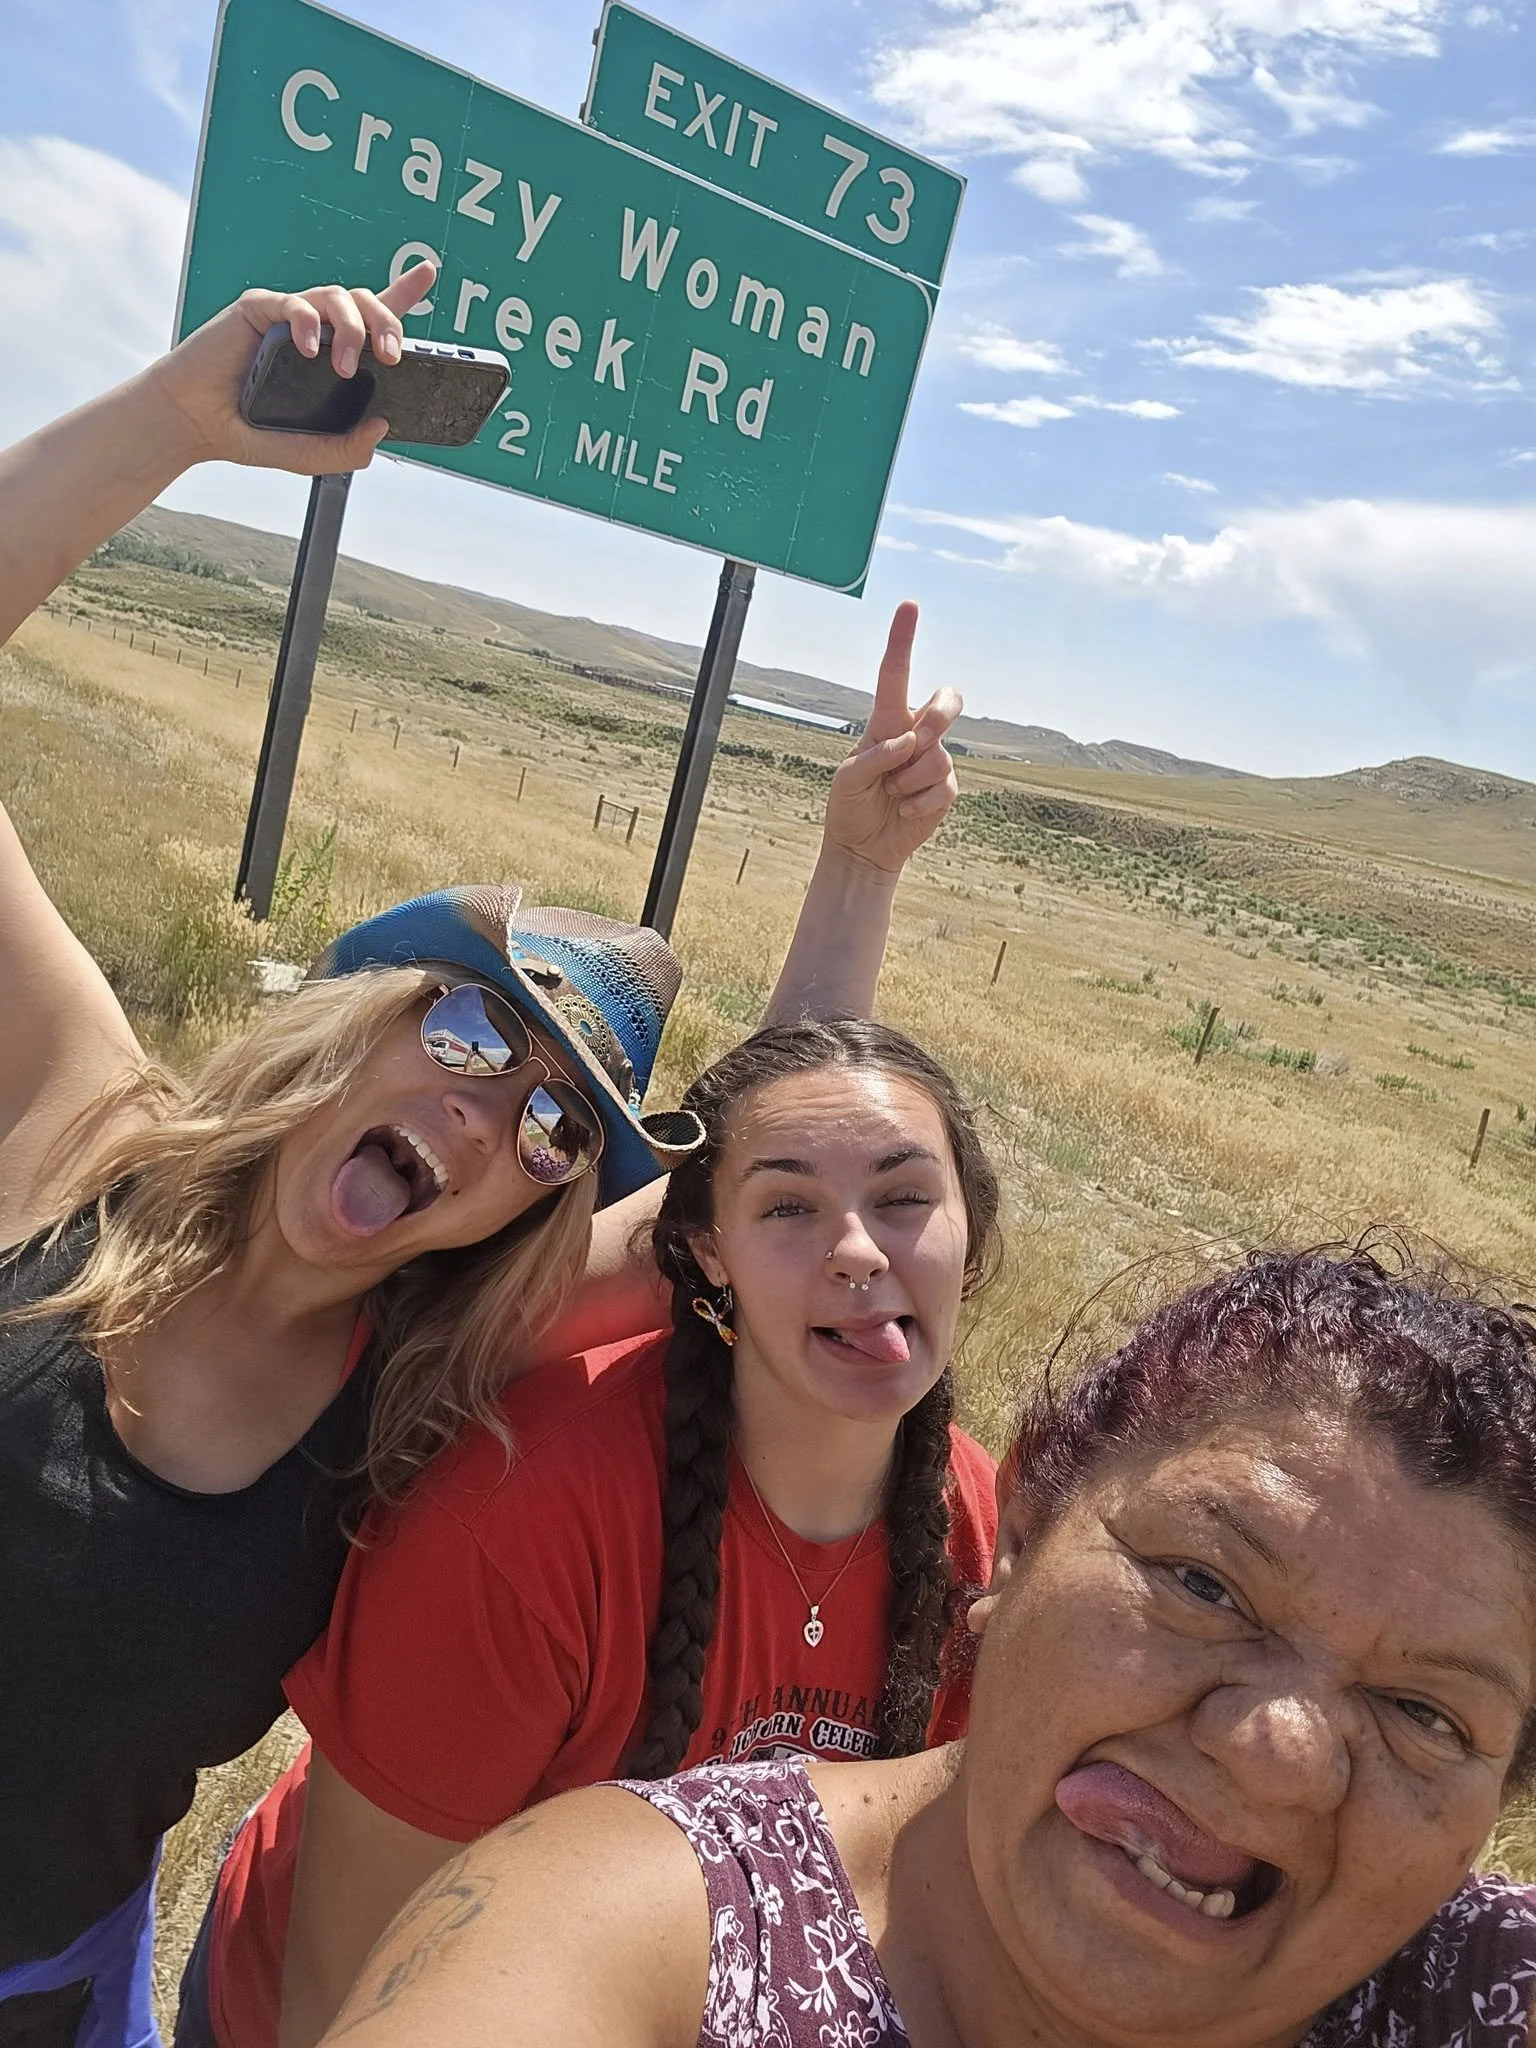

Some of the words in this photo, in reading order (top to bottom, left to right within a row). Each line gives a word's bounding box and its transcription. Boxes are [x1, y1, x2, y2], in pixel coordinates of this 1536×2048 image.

[644, 62, 779, 169] EXIT
[823, 134, 915, 245] 73
[280, 69, 562, 263] Crazy
[620, 207, 876, 378] Woman
[574, 422, 683, 495] MILE
[680, 347, 774, 440] Rd
